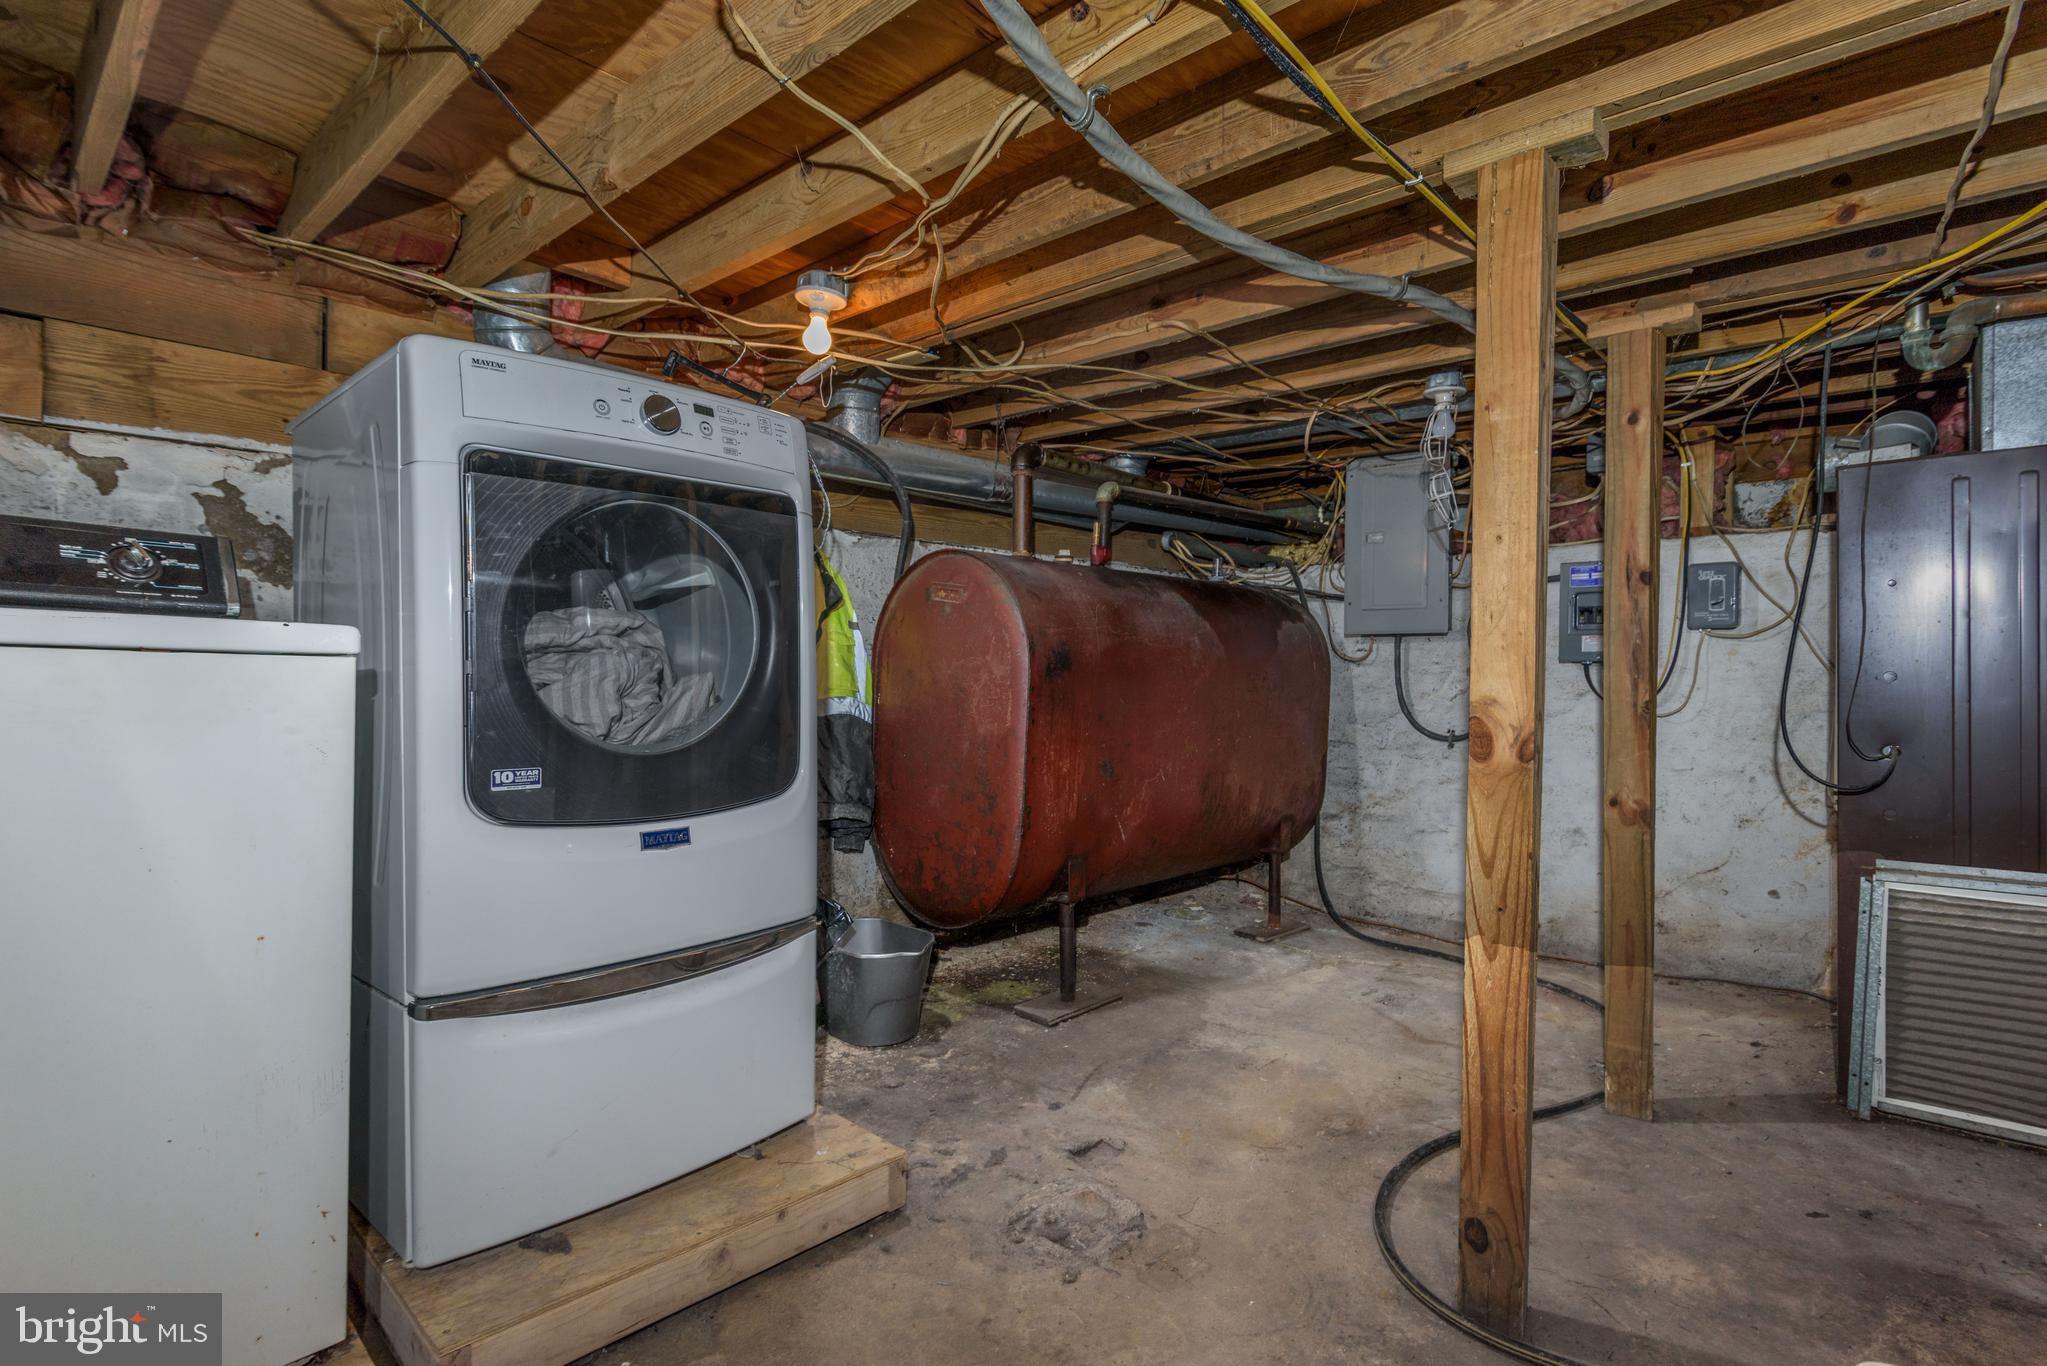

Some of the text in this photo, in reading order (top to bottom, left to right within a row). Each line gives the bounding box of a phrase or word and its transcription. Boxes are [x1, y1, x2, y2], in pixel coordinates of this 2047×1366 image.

[471, 357, 507, 370] MAYTAG
[493, 771, 514, 784] 10
[645, 831, 688, 847] MAYTAG
